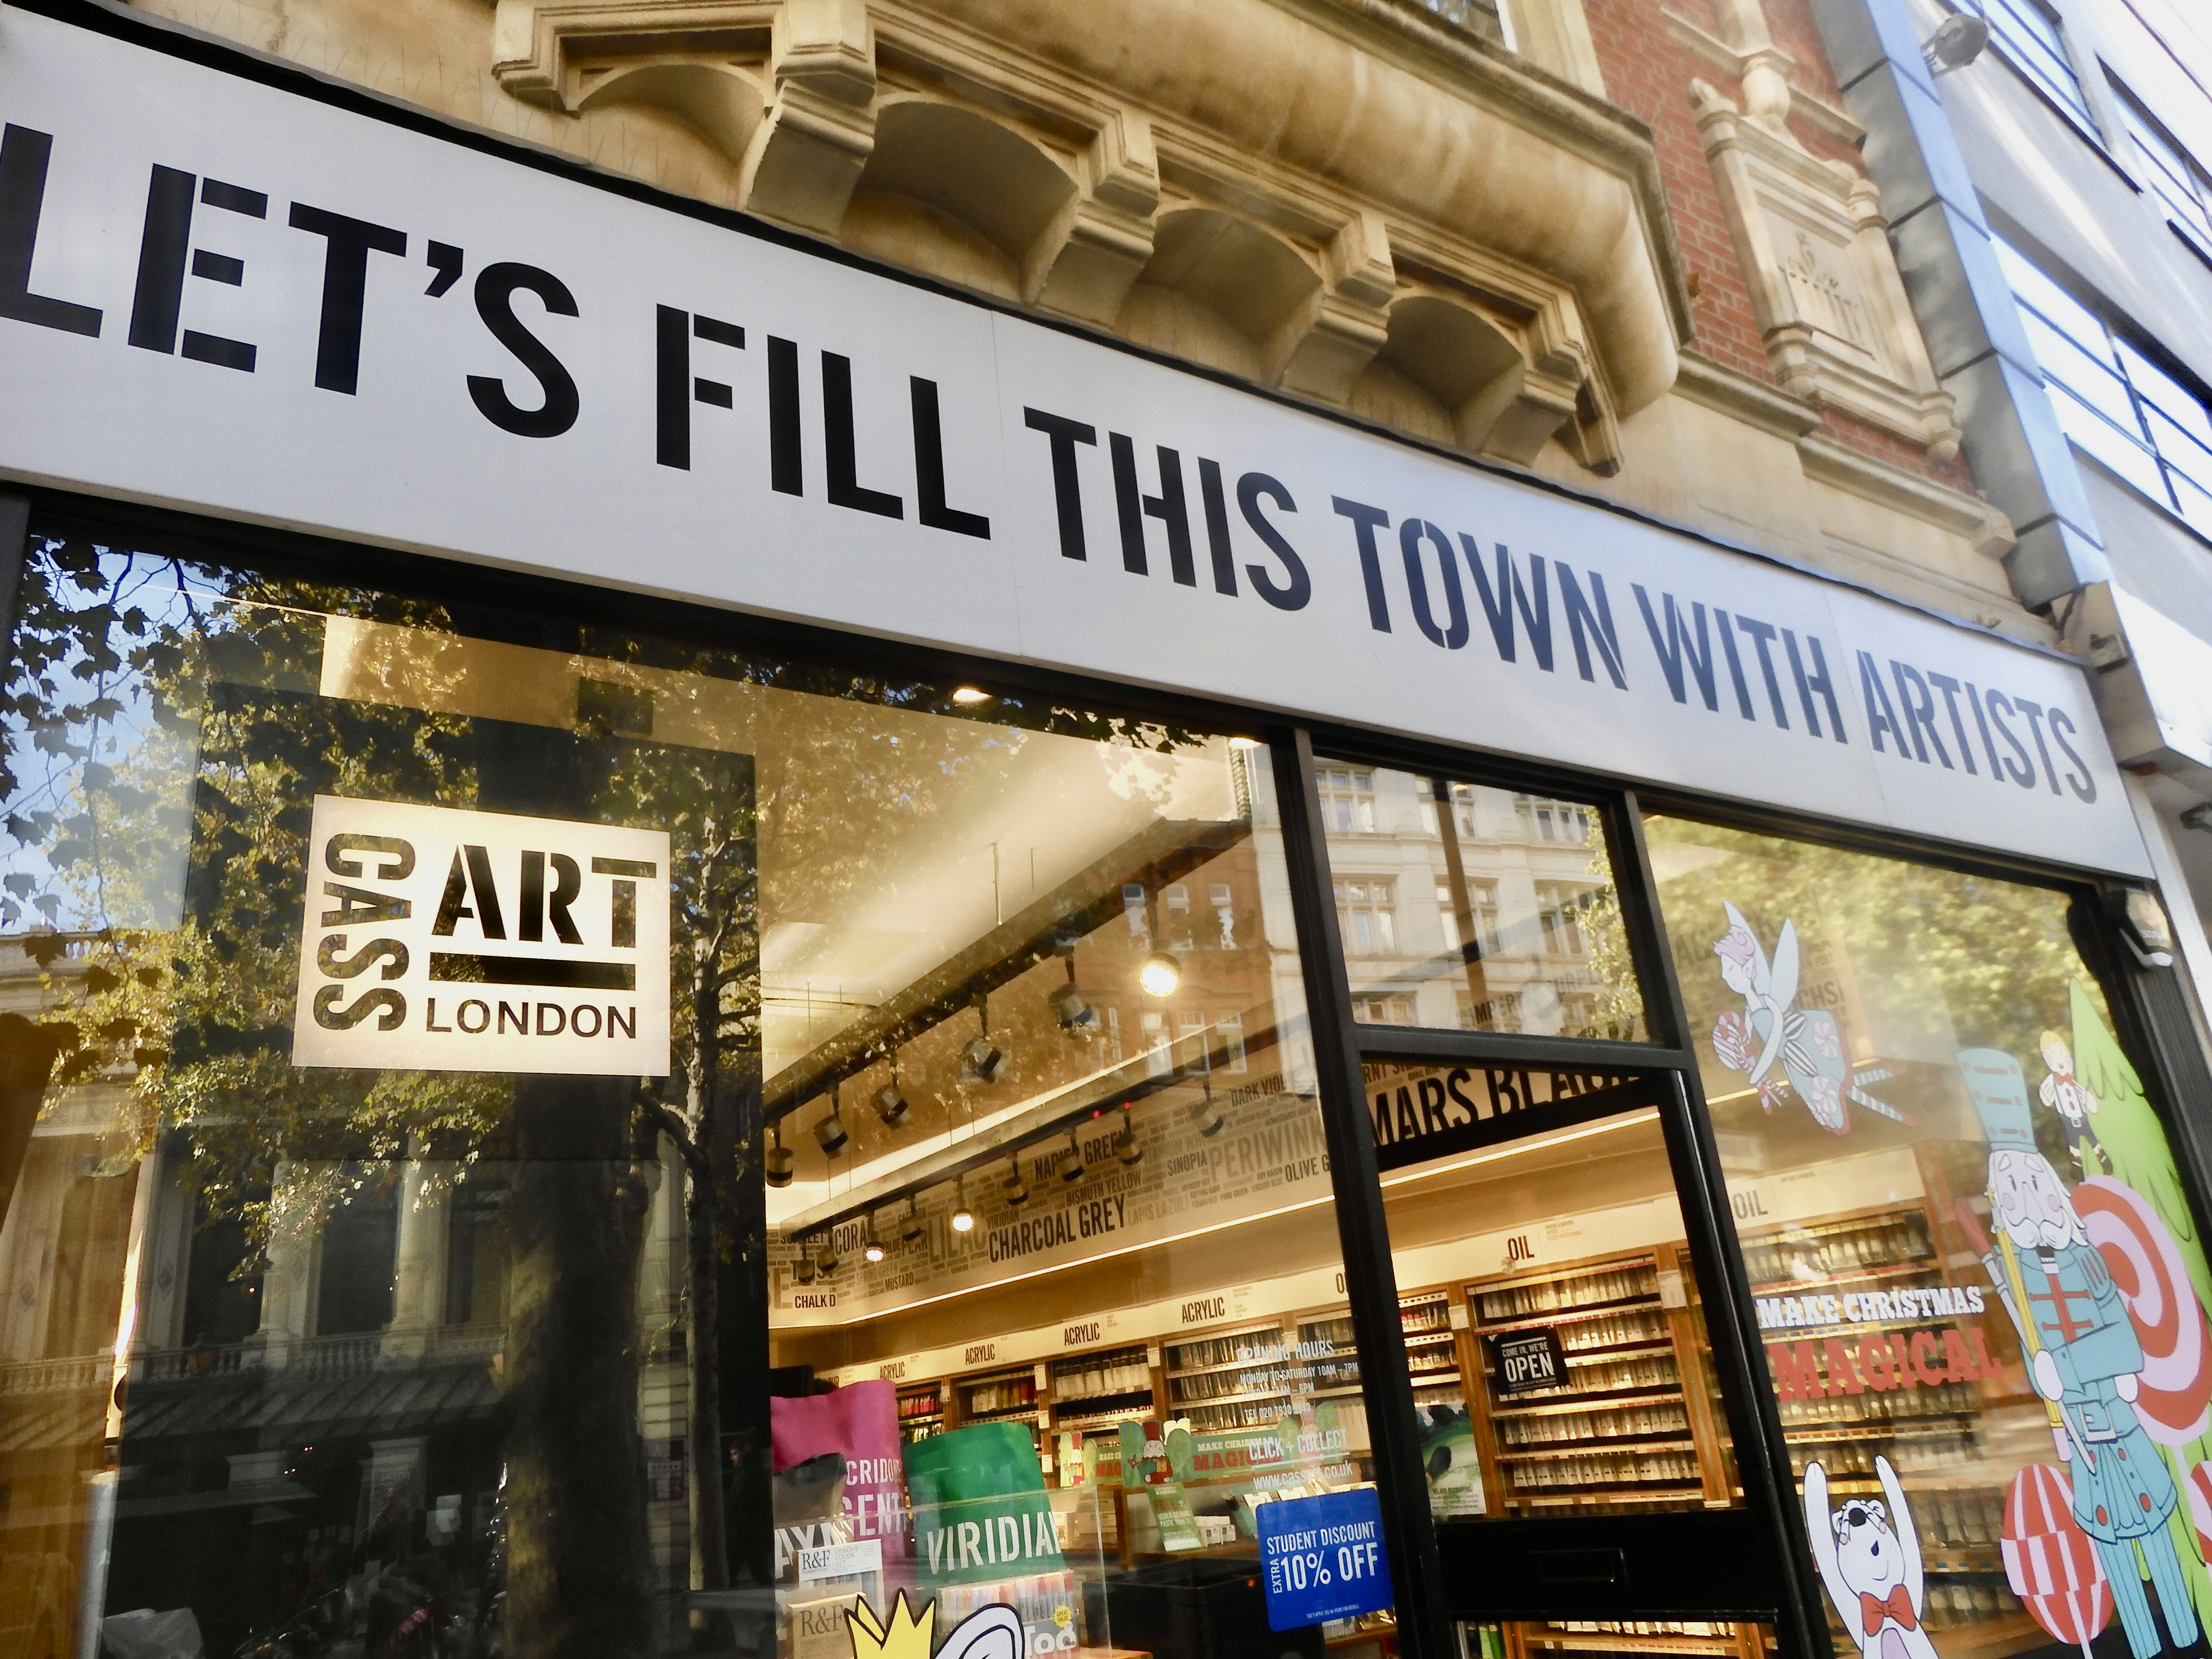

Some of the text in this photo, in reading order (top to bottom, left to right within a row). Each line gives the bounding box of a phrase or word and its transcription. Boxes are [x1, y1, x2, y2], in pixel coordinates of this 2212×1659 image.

[657, 303, 990, 540] FILL
[1023, 406, 1310, 611] THIS
[1331, 495, 1628, 691] TOWN
[1632, 582, 1848, 745] WITH
[1855, 649, 2097, 805] ARTISTS
[432, 844, 657, 949] ART
[313, 833, 416, 1032] CASS
[426, 998, 637, 1039] LONDON
[1167, 1150, 1207, 1176] SINOPIA
[1285, 1157, 1318, 1182] OLIVE
[1066, 1169, 1141, 1207] BISMUTH YELLOW
[1732, 1190, 1768, 1220] OIL
[989, 1193, 1124, 1263] CHARCOAL GREY
[1508, 1235, 1535, 1261] OIL
[885, 1272, 914, 1291] MUSTARD
[795, 1295, 827, 1308] CHALK
[1182, 1297, 1225, 1324] ACRYLIC
[1756, 1286, 1985, 1329] MAKE CHRISTMAS
[1064, 1322, 1100, 1346] ACRYLIC
[965, 1344, 995, 1365] ACRYLIC
[1236, 1340, 1334, 1365] OPENING HOURS
[1502, 1347, 1518, 1357] COME
[1767, 1326, 2004, 1402] MAGICAL
[880, 1361, 905, 1380] ACRYLIC
[1240, 1371, 1269, 1384] MONDAY
[1281, 1367, 1315, 1380] SATURDAY
[1318, 1364, 1336, 1376] 10AM
[1344, 1362, 1359, 1373] 7PM
[1505, 1352, 1555, 1382] OPEN
[1299, 1382, 1315, 1394] 6PM
[1259, 1407, 1273, 1419] 020
[1198, 1442, 1224, 1452] MAKE
[1249, 1437, 1284, 1461] CLICK
[1297, 1429, 1347, 1454] COLLECT
[835, 1545, 858, 1554] OPAQUE
[1267, 1521, 1375, 1555] STUDENT DISCOUNT
[802, 1550, 830, 1570] R&F
[1281, 1542, 1378, 1591] 10% OFF
[1270, 1558, 1282, 1594] EXTRA
[800, 1604, 843, 1637] R&F
